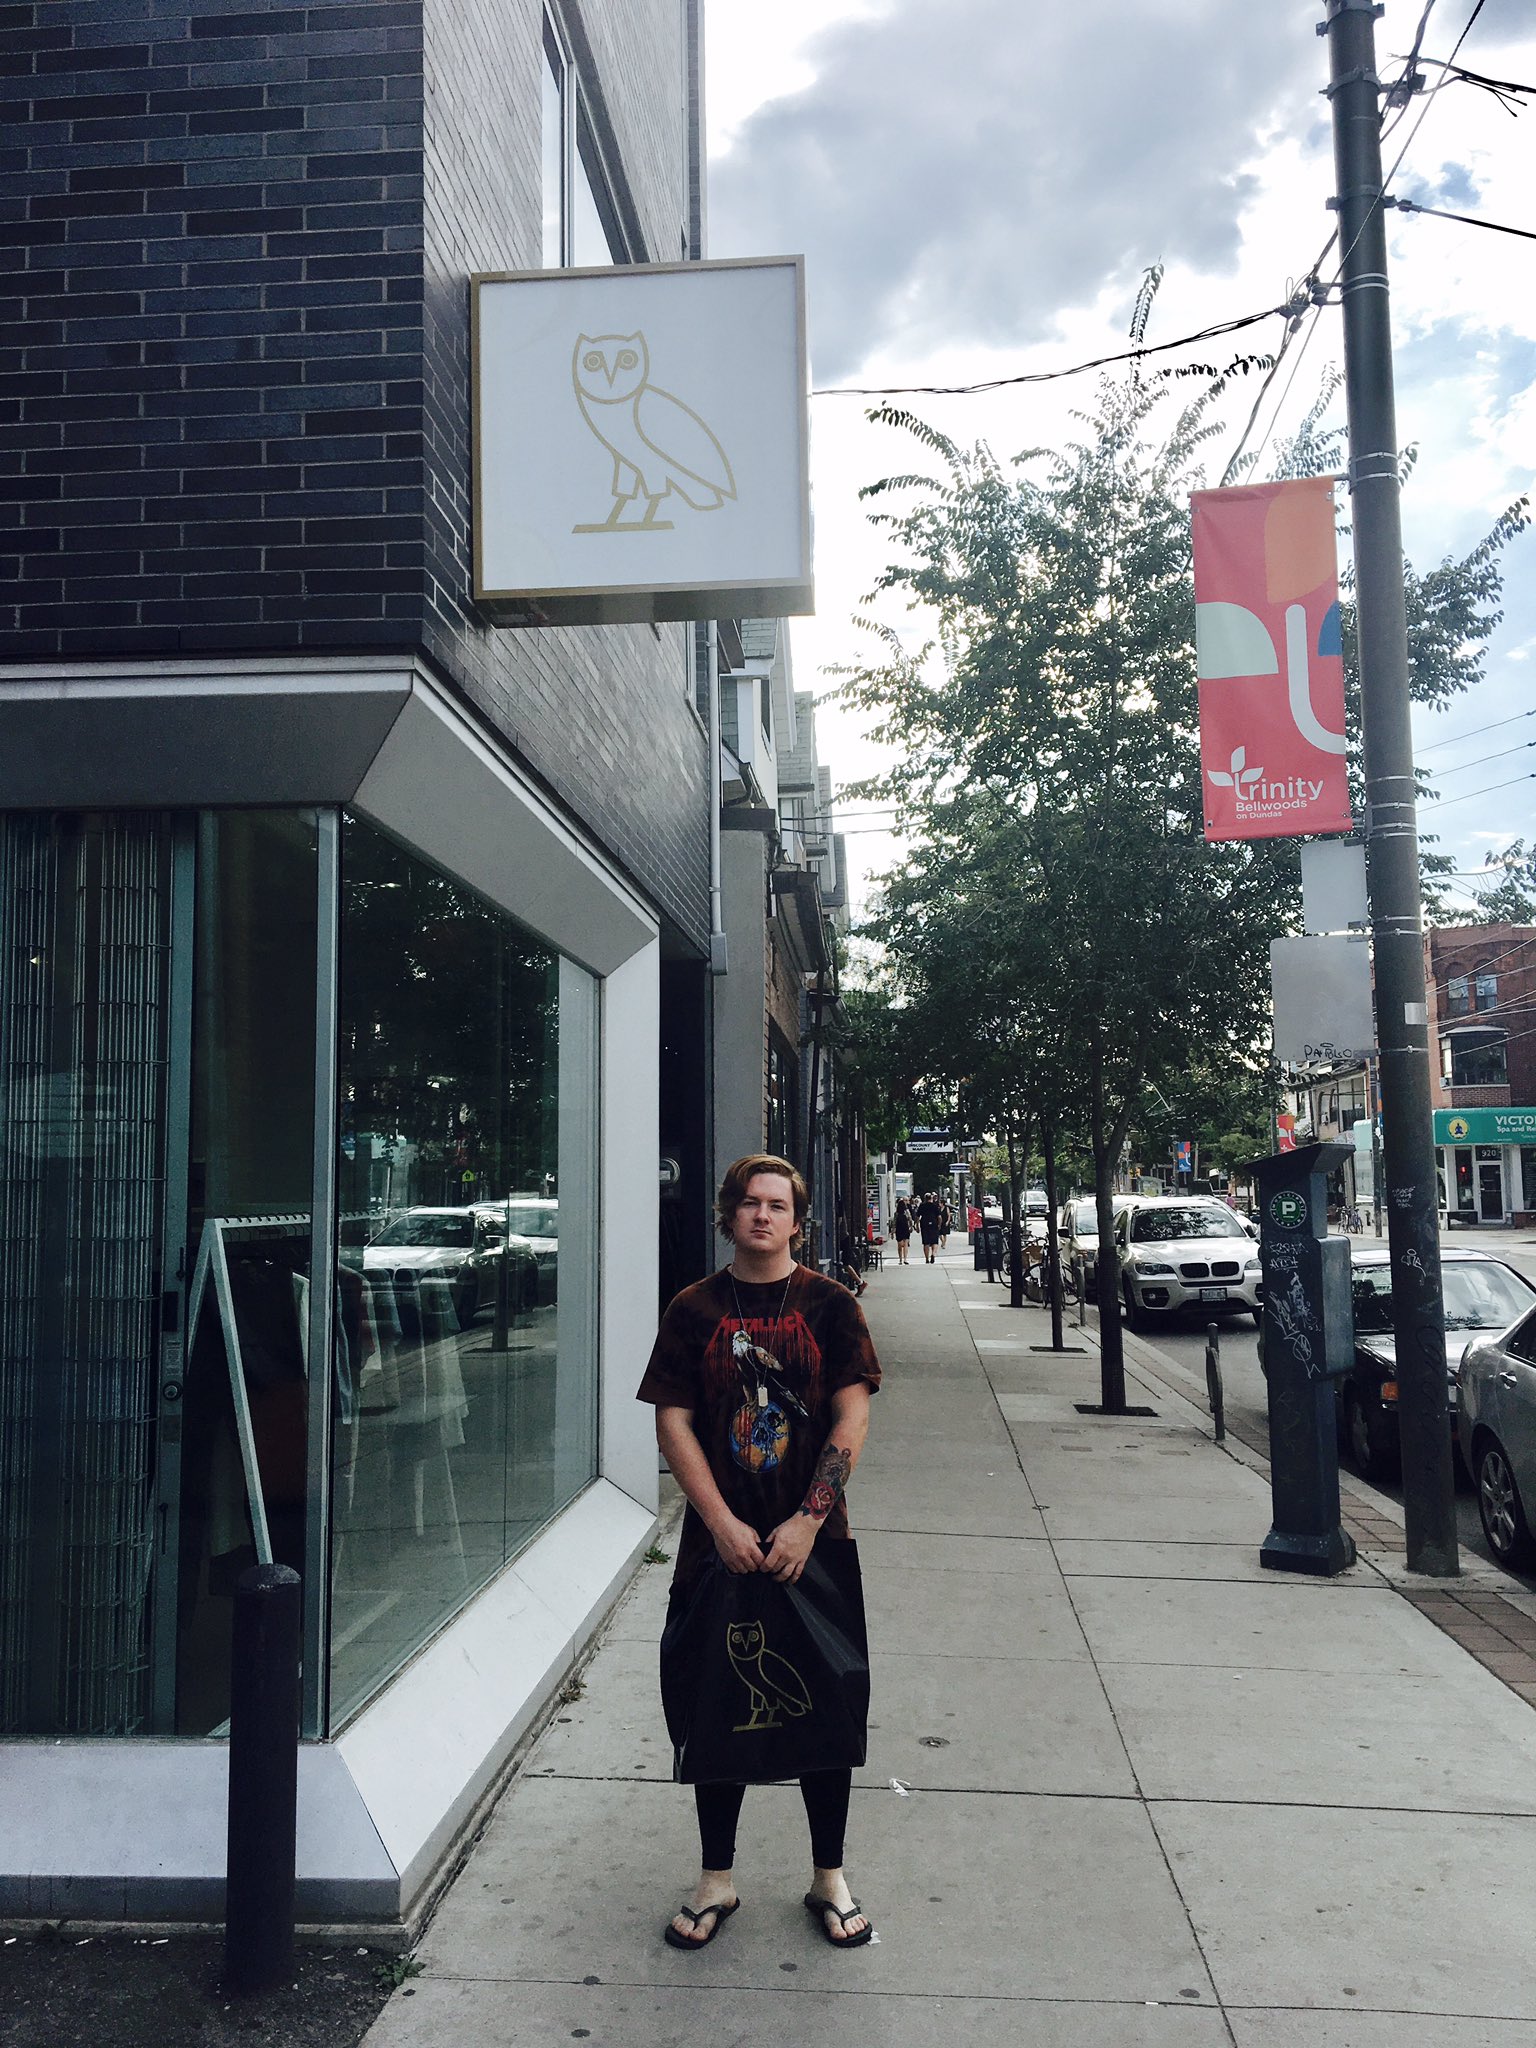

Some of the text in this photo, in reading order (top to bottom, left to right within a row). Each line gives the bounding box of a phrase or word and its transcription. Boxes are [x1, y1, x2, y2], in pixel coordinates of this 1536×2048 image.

[1235, 799, 1308, 812] Bellwoods
[1249, 811, 1283, 819] Dundas
[1495, 1115, 1536, 1125] VICTO
[1481, 1150, 1497, 1158] 920
[1281, 1201, 1296, 1215] P
